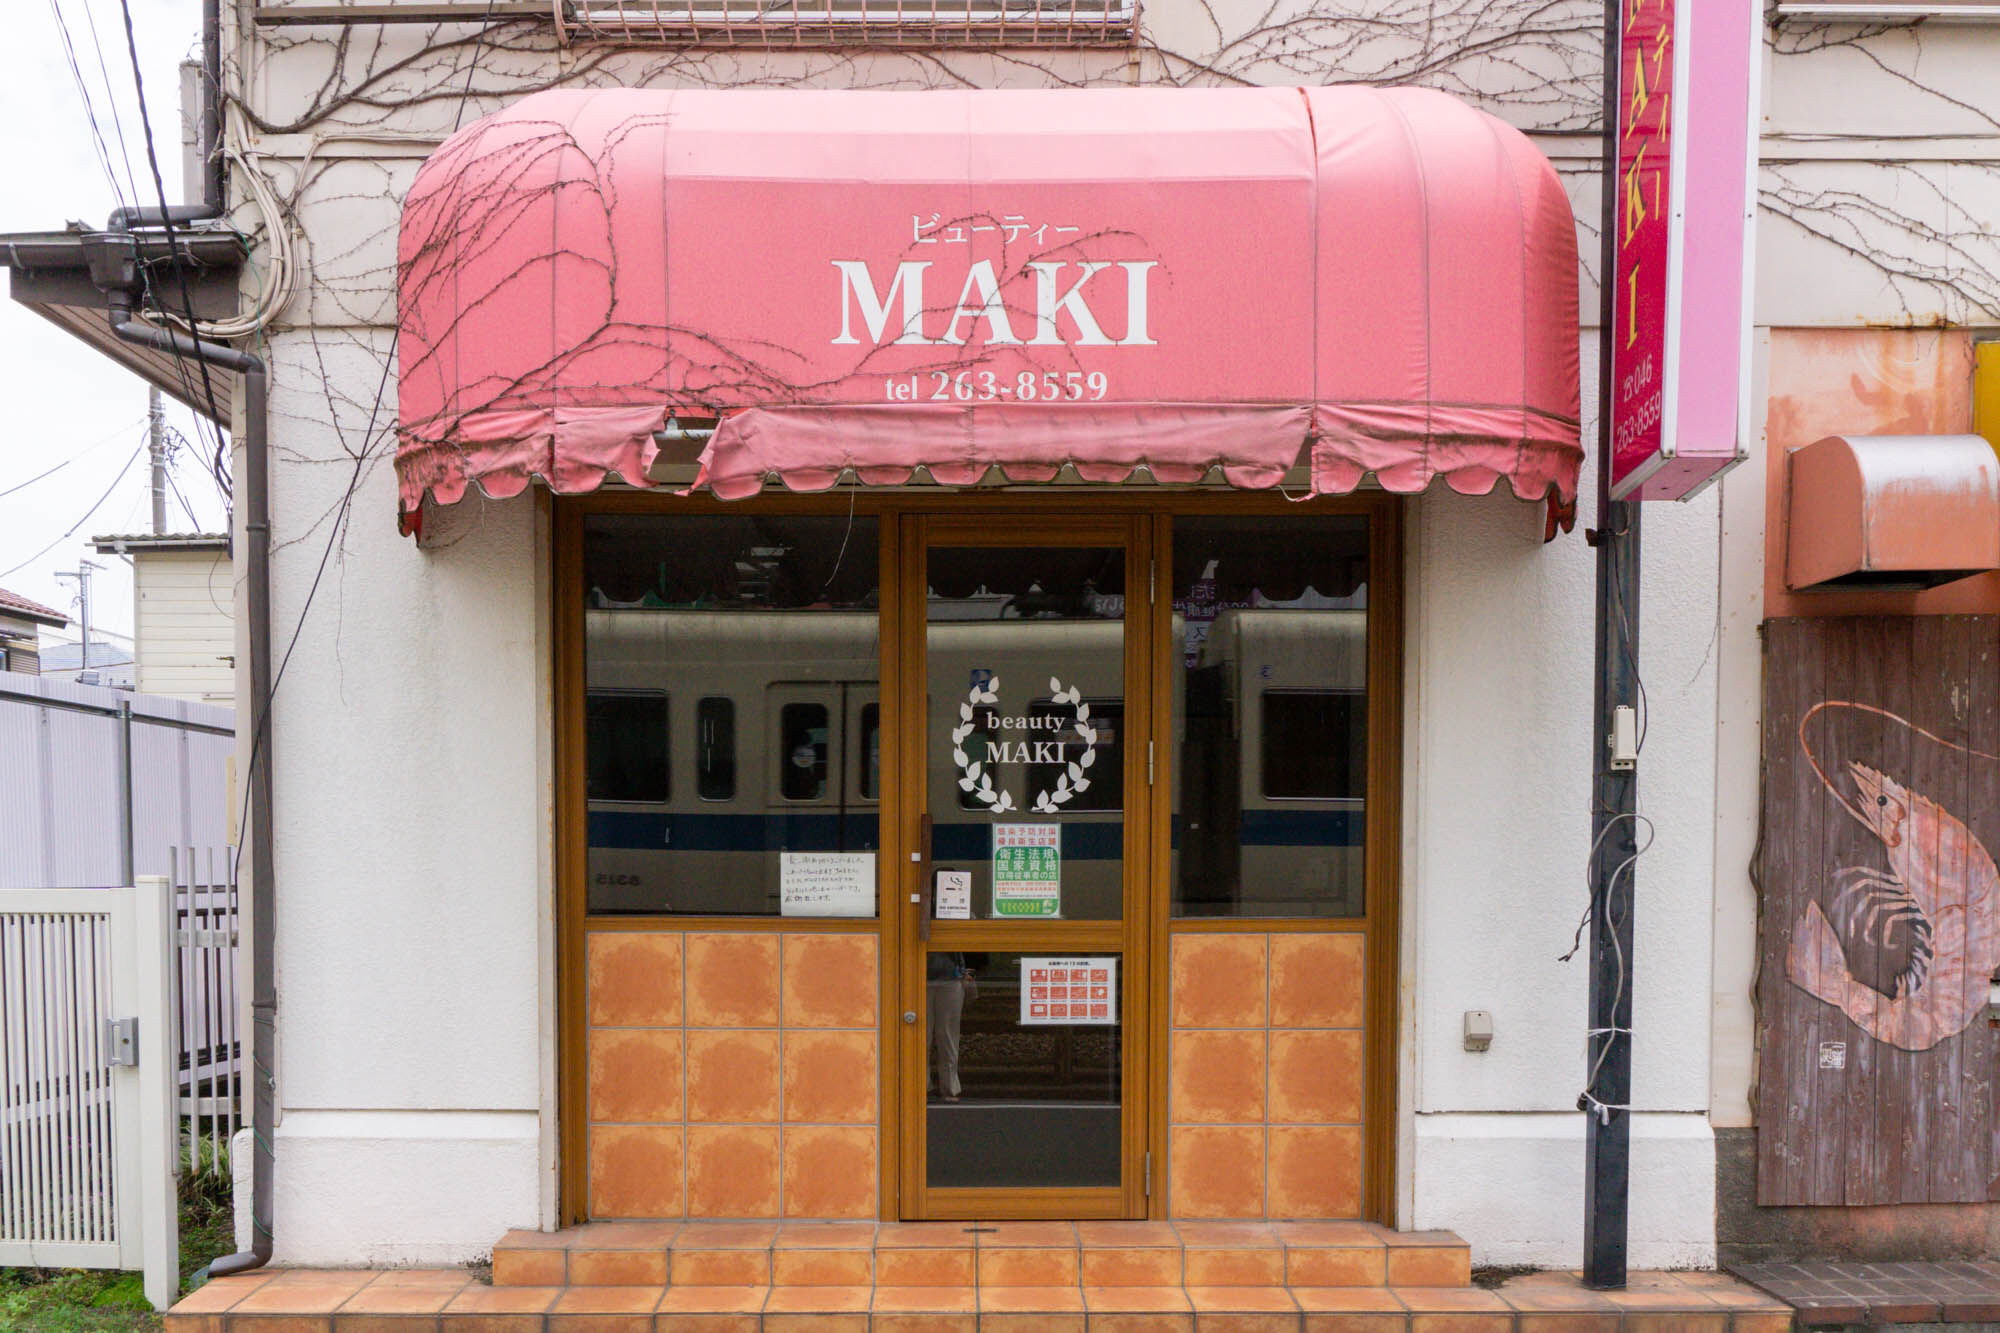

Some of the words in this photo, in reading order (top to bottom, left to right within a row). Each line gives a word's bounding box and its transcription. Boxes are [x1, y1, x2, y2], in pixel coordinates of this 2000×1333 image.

[1653, 0, 1671, 221] ティー
[913, 213, 1080, 245] ビューティー
[831, 259, 1158, 345] MAKI
[886, 375, 918, 401] tel
[931, 371, 1108, 401] 263-8559
[1634, 353, 1653, 395] 046
[986, 711, 1066, 733] beauty
[985, 741, 1066, 763] MAKI
